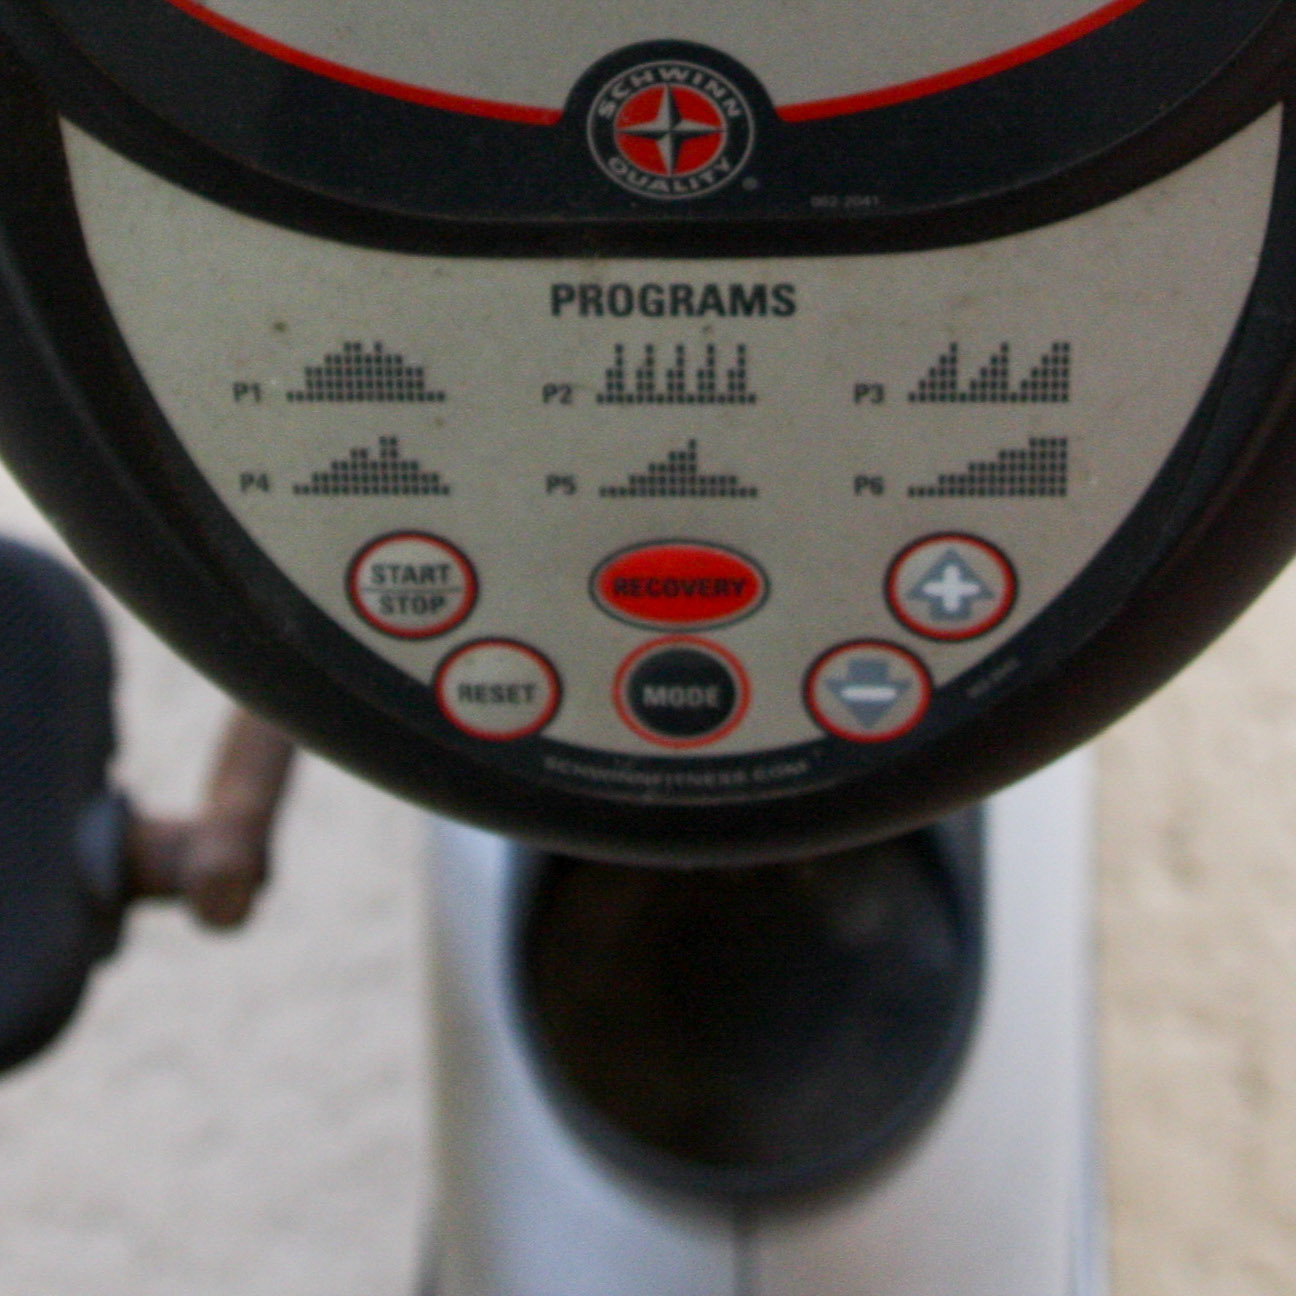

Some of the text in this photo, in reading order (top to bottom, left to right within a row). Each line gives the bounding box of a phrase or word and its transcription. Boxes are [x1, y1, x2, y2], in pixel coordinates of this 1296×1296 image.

[598, 65, 742, 119] SCHWINN
[608, 155, 732, 193] QUALITY
[550, 283, 798, 319] PROGRAMS
[232, 382, 264, 405] P1
[542, 384, 574, 406] P2
[853, 383, 886, 405] P3
[239, 473, 271, 495] P4
[546, 474, 577, 497] P5
[854, 474, 885, 497] P6
[370, 563, 452, 585] START
[613, 576, 747, 598] RECOVERY
[378, 594, 447, 616] STOP
[458, 683, 537, 704] RESET
[642, 685, 721, 708] MODE
